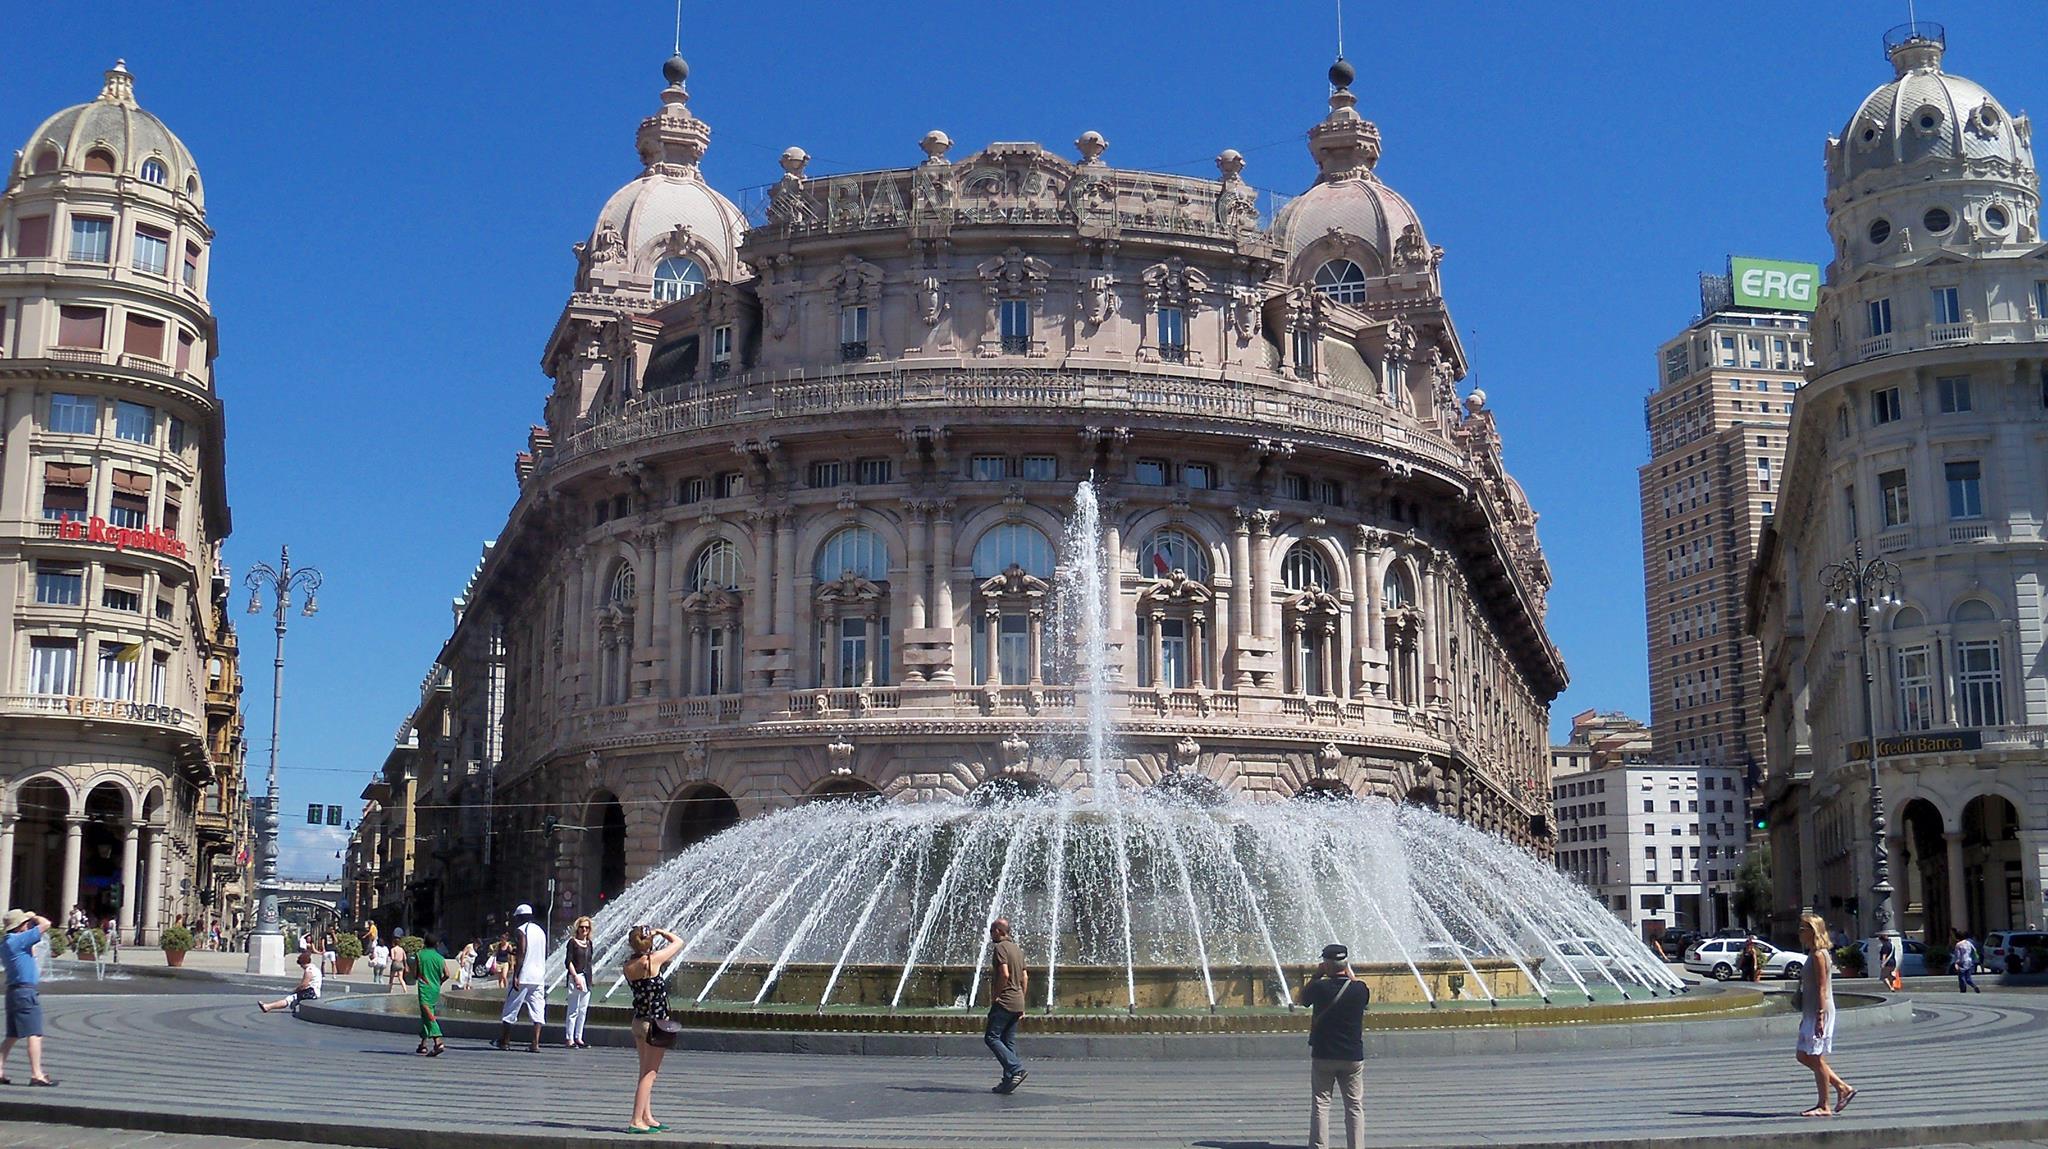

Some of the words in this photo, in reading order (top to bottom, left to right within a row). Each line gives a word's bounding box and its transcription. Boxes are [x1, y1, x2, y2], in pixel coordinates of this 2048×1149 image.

[1741, 268, 1811, 301] ERG
[87, 515, 186, 560] Repubblica
[1918, 737, 1962, 752] Banca
